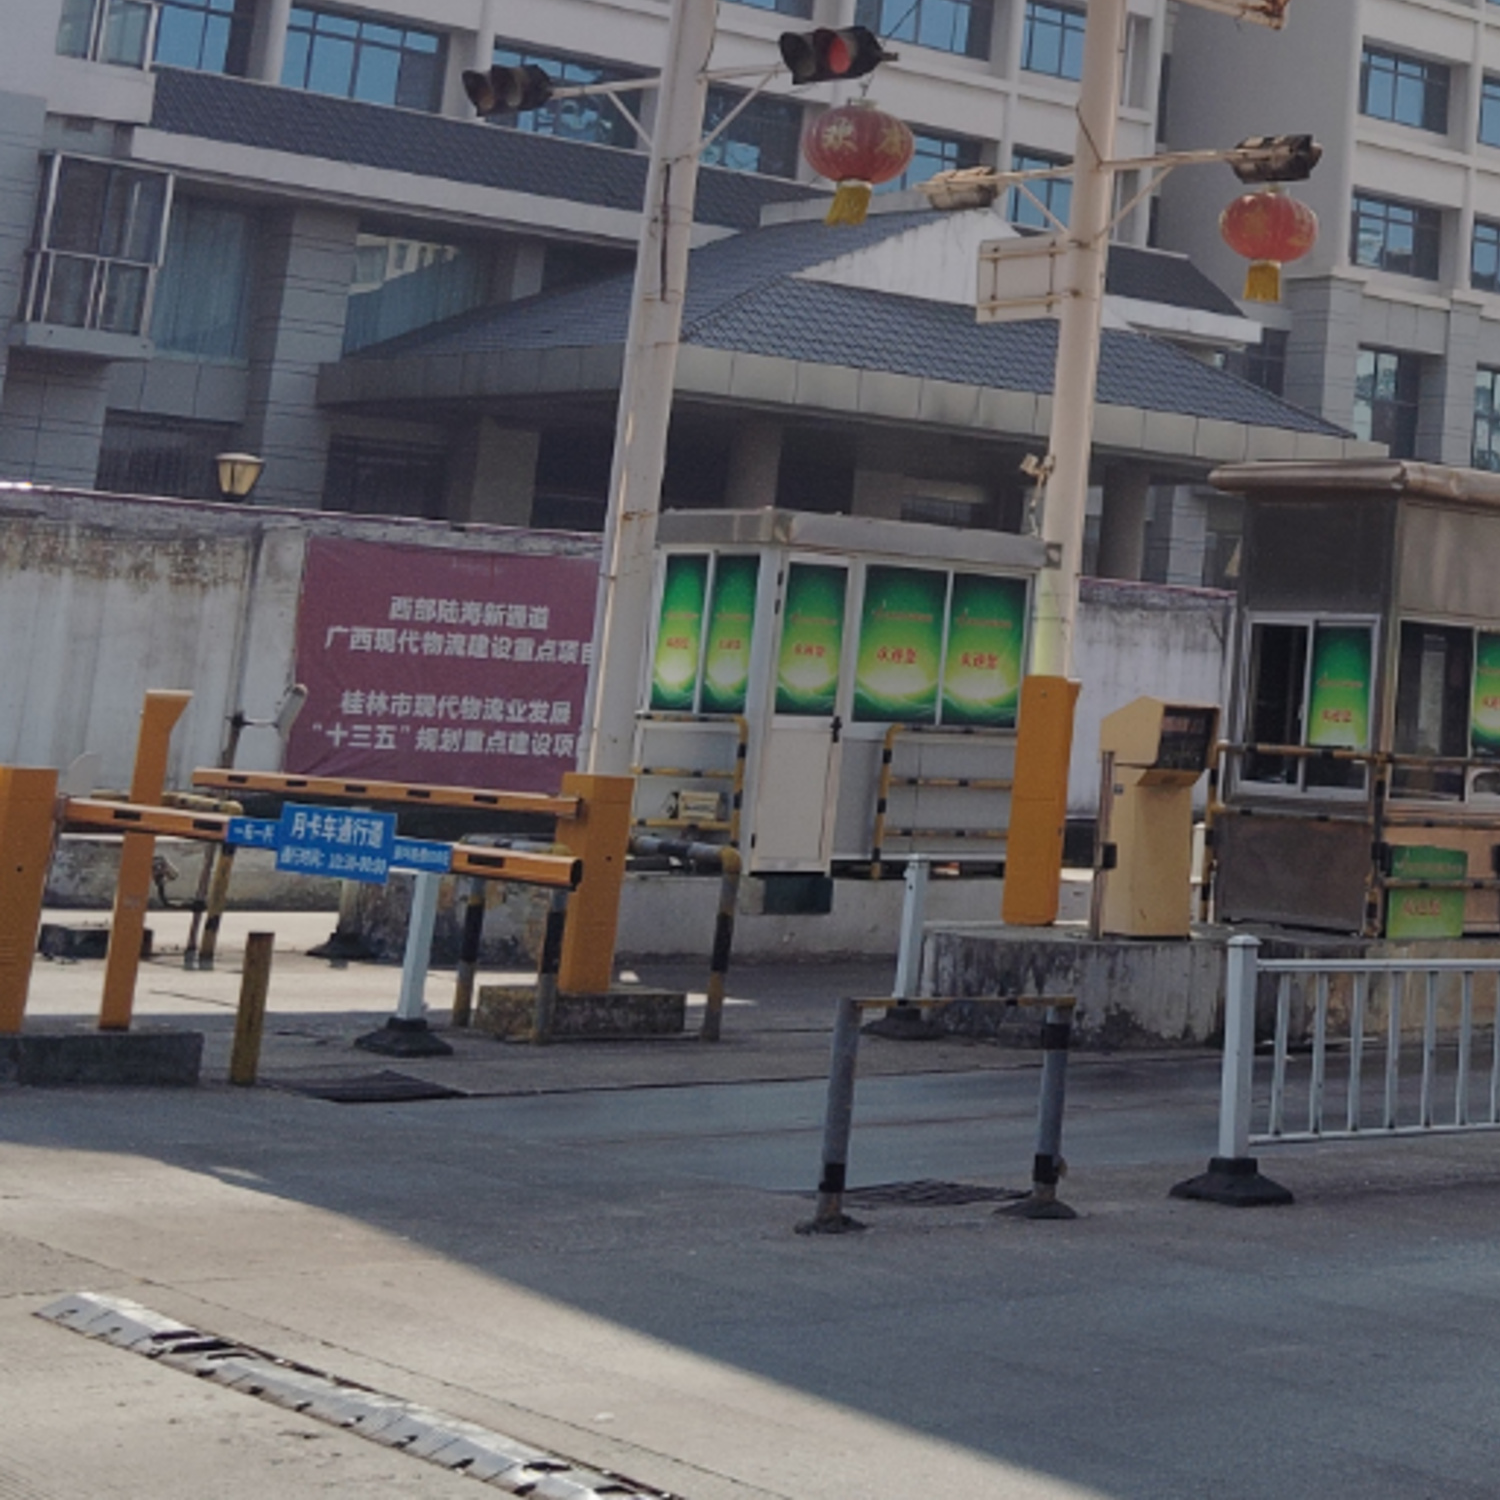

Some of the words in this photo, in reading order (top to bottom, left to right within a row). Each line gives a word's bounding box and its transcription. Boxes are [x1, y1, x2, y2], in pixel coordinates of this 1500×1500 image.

[388, 596, 550, 630] 西部陆海新通道
[324, 625, 594, 665] 广西现代物流建设重点项目
[340, 689, 573, 726] 桂林市现代物流业发展
[311, 721, 585, 758] “十三五”规划重点建设项
[290, 812, 384, 849] 月卡车通行道
